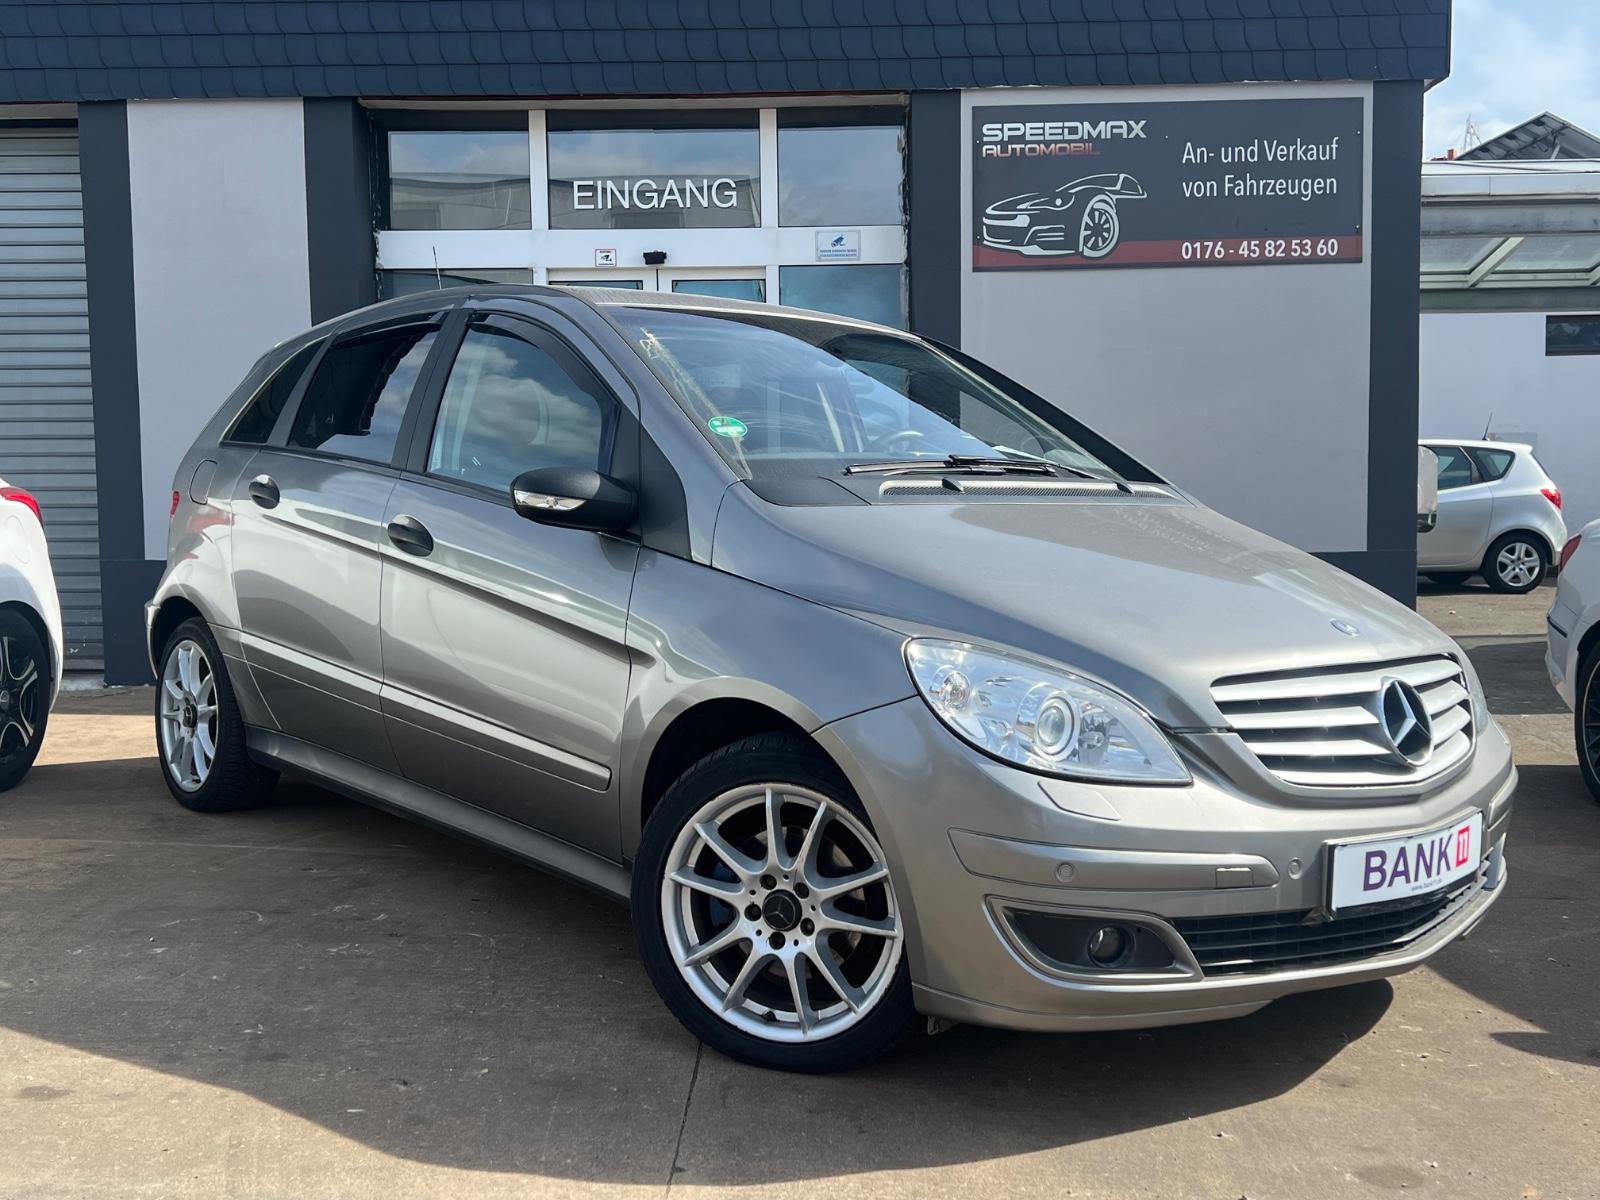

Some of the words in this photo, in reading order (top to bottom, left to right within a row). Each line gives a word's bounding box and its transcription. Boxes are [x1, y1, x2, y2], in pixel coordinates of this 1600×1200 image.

[982, 120, 1147, 142] SPEEDMAX
[982, 142, 1101, 158] AUTOMOBIL
[1182, 142, 1215, 164] An-
[1221, 139, 1258, 163] und
[1263, 136, 1339, 162] Verkauf
[573, 178, 738, 210] EINGANG
[1182, 181, 1217, 198] von
[1224, 173, 1337, 201] Fahrzeugen
[1181, 241, 1225, 260] 0176
[1238, 240, 1260, 258] 45
[1264, 239, 1286, 257] 82
[1290, 239, 1312, 257] 53
[1316, 238, 1339, 256] 60
